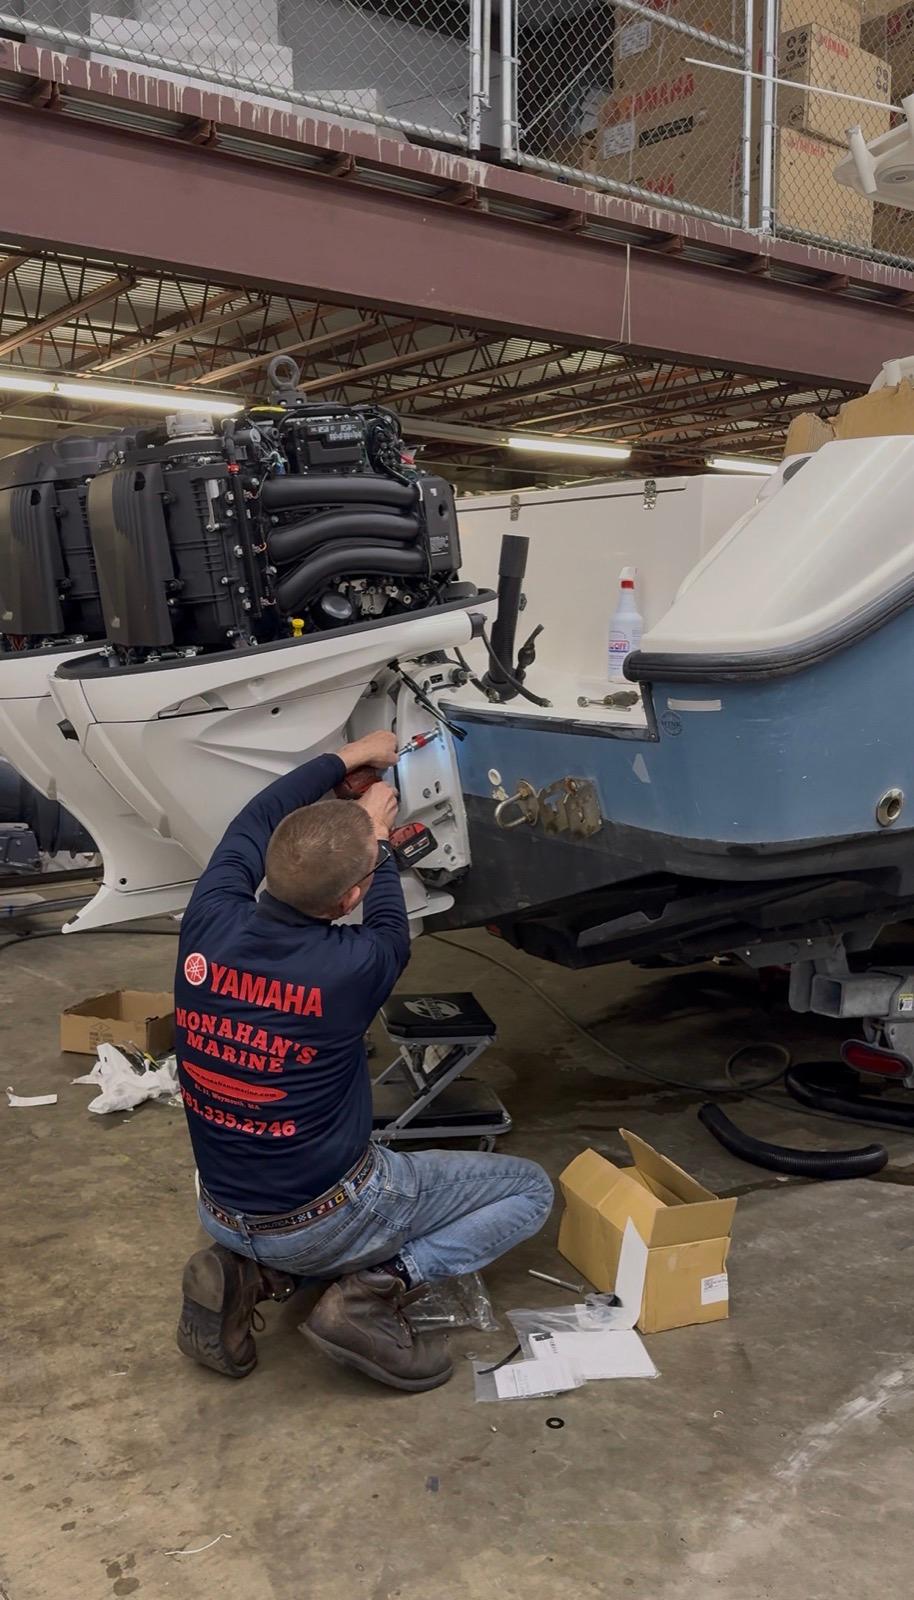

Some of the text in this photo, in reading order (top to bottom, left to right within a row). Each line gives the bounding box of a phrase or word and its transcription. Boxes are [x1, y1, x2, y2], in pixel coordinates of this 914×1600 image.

[210, 962, 323, 1018] YAMAHA
[176, 1007, 318, 1065] MONAHAN'S
[186, 1030, 285, 1073] MARINE
